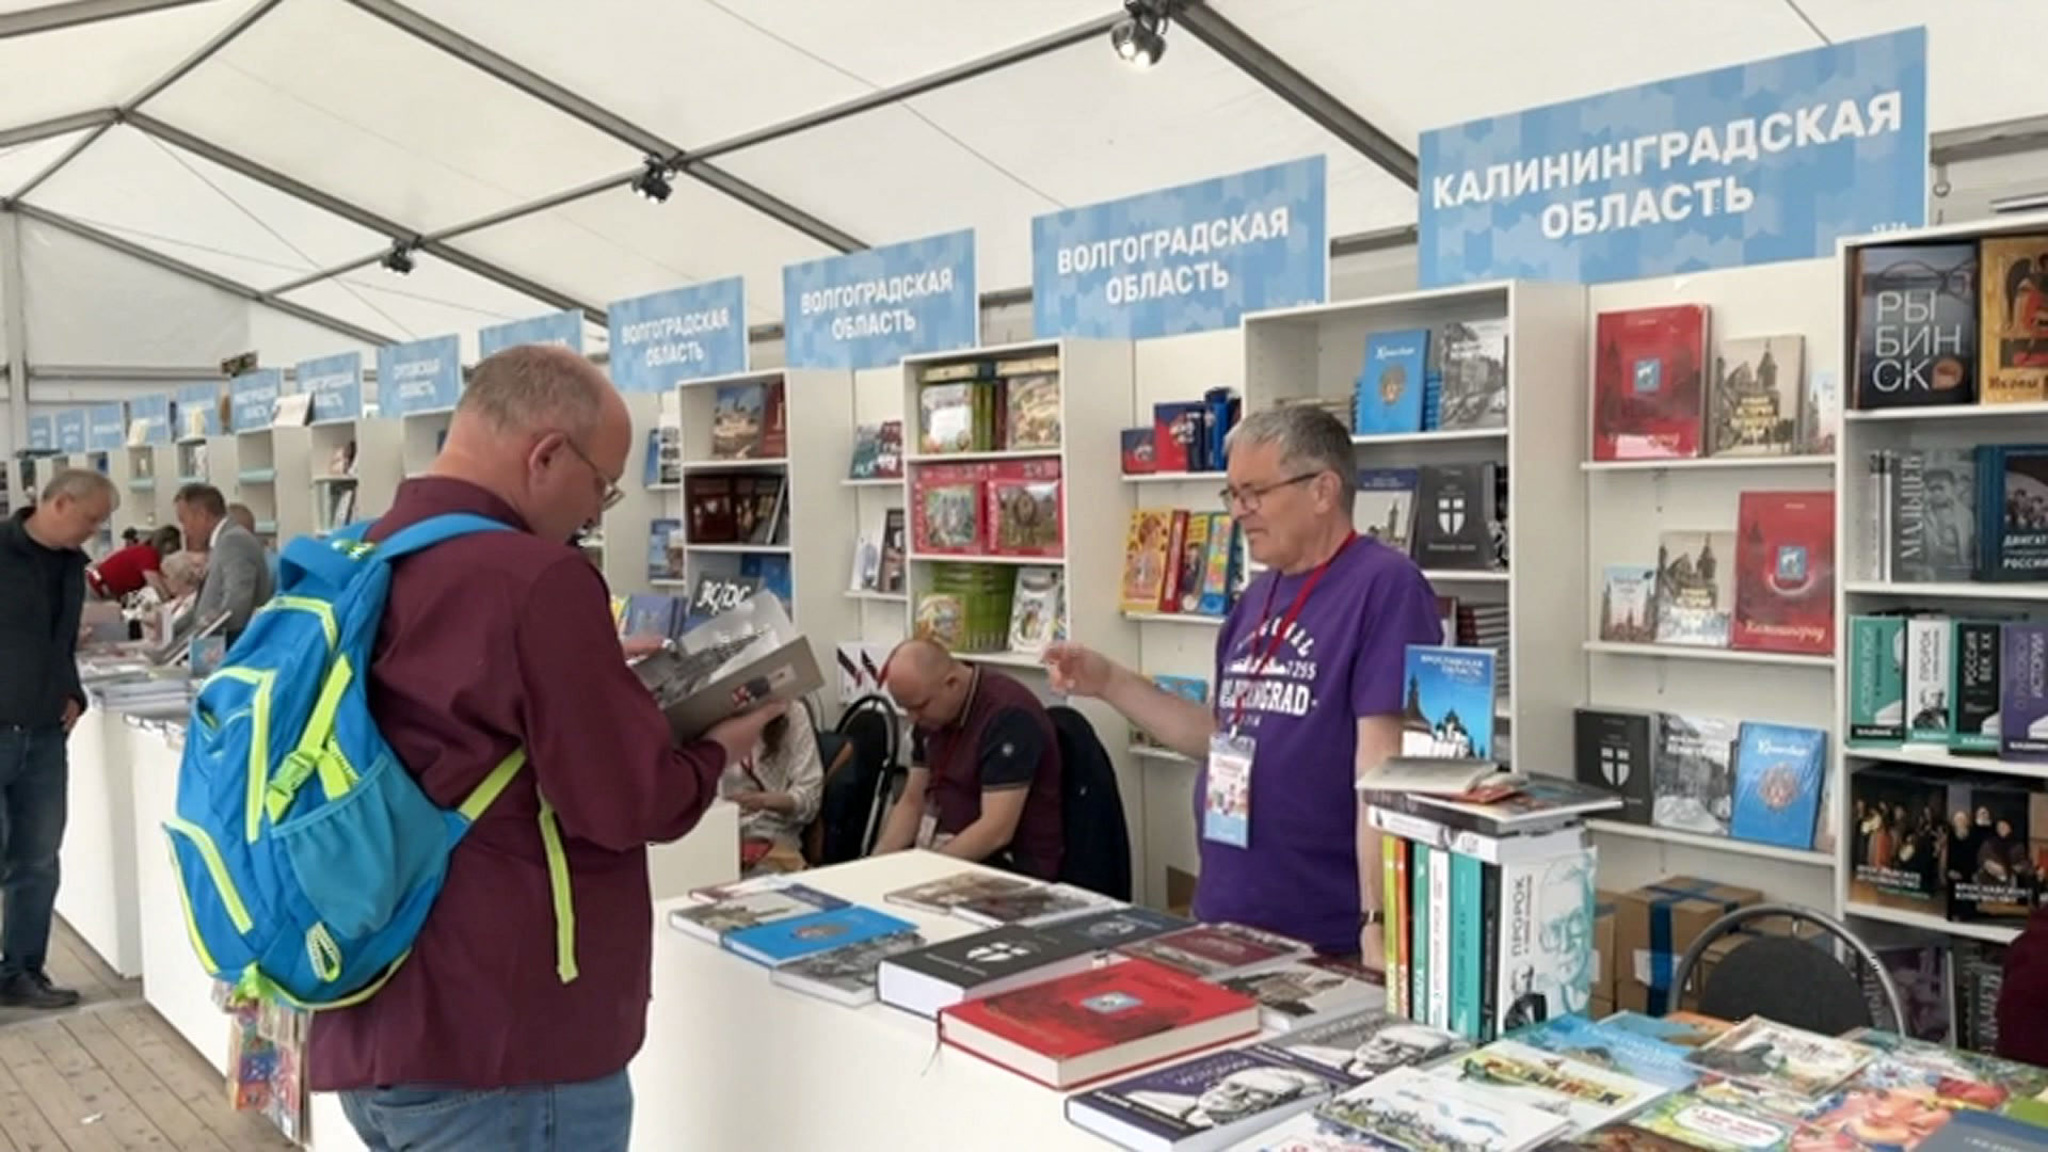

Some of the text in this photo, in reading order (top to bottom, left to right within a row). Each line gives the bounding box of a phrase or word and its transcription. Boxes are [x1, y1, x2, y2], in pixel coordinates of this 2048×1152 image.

[1432, 91, 1903, 209] КАЛИНИНГРАДСКАЯ
[1541, 178, 1754, 241] ОБЛАСТЬ
[1058, 206, 1290, 274] ВОЛГОГРАДСКАЯ
[801, 268, 953, 314] ВОЛГОГРАДСКАЯ
[1106, 263, 1229, 304] ОБЛАСТЬ
[831, 309, 916, 340] ОБЛАСТЬ
[1877, 289, 1936, 324] РЫ
[622, 308, 731, 346] ВОЛГОГРАДСКАЯ
[1875, 324, 1962, 357] БИН
[646, 342, 704, 368] ОБЛАСТЬ
[1872, 358, 1932, 392] СК
[1511, 877, 1525, 957] ПРОРОК
